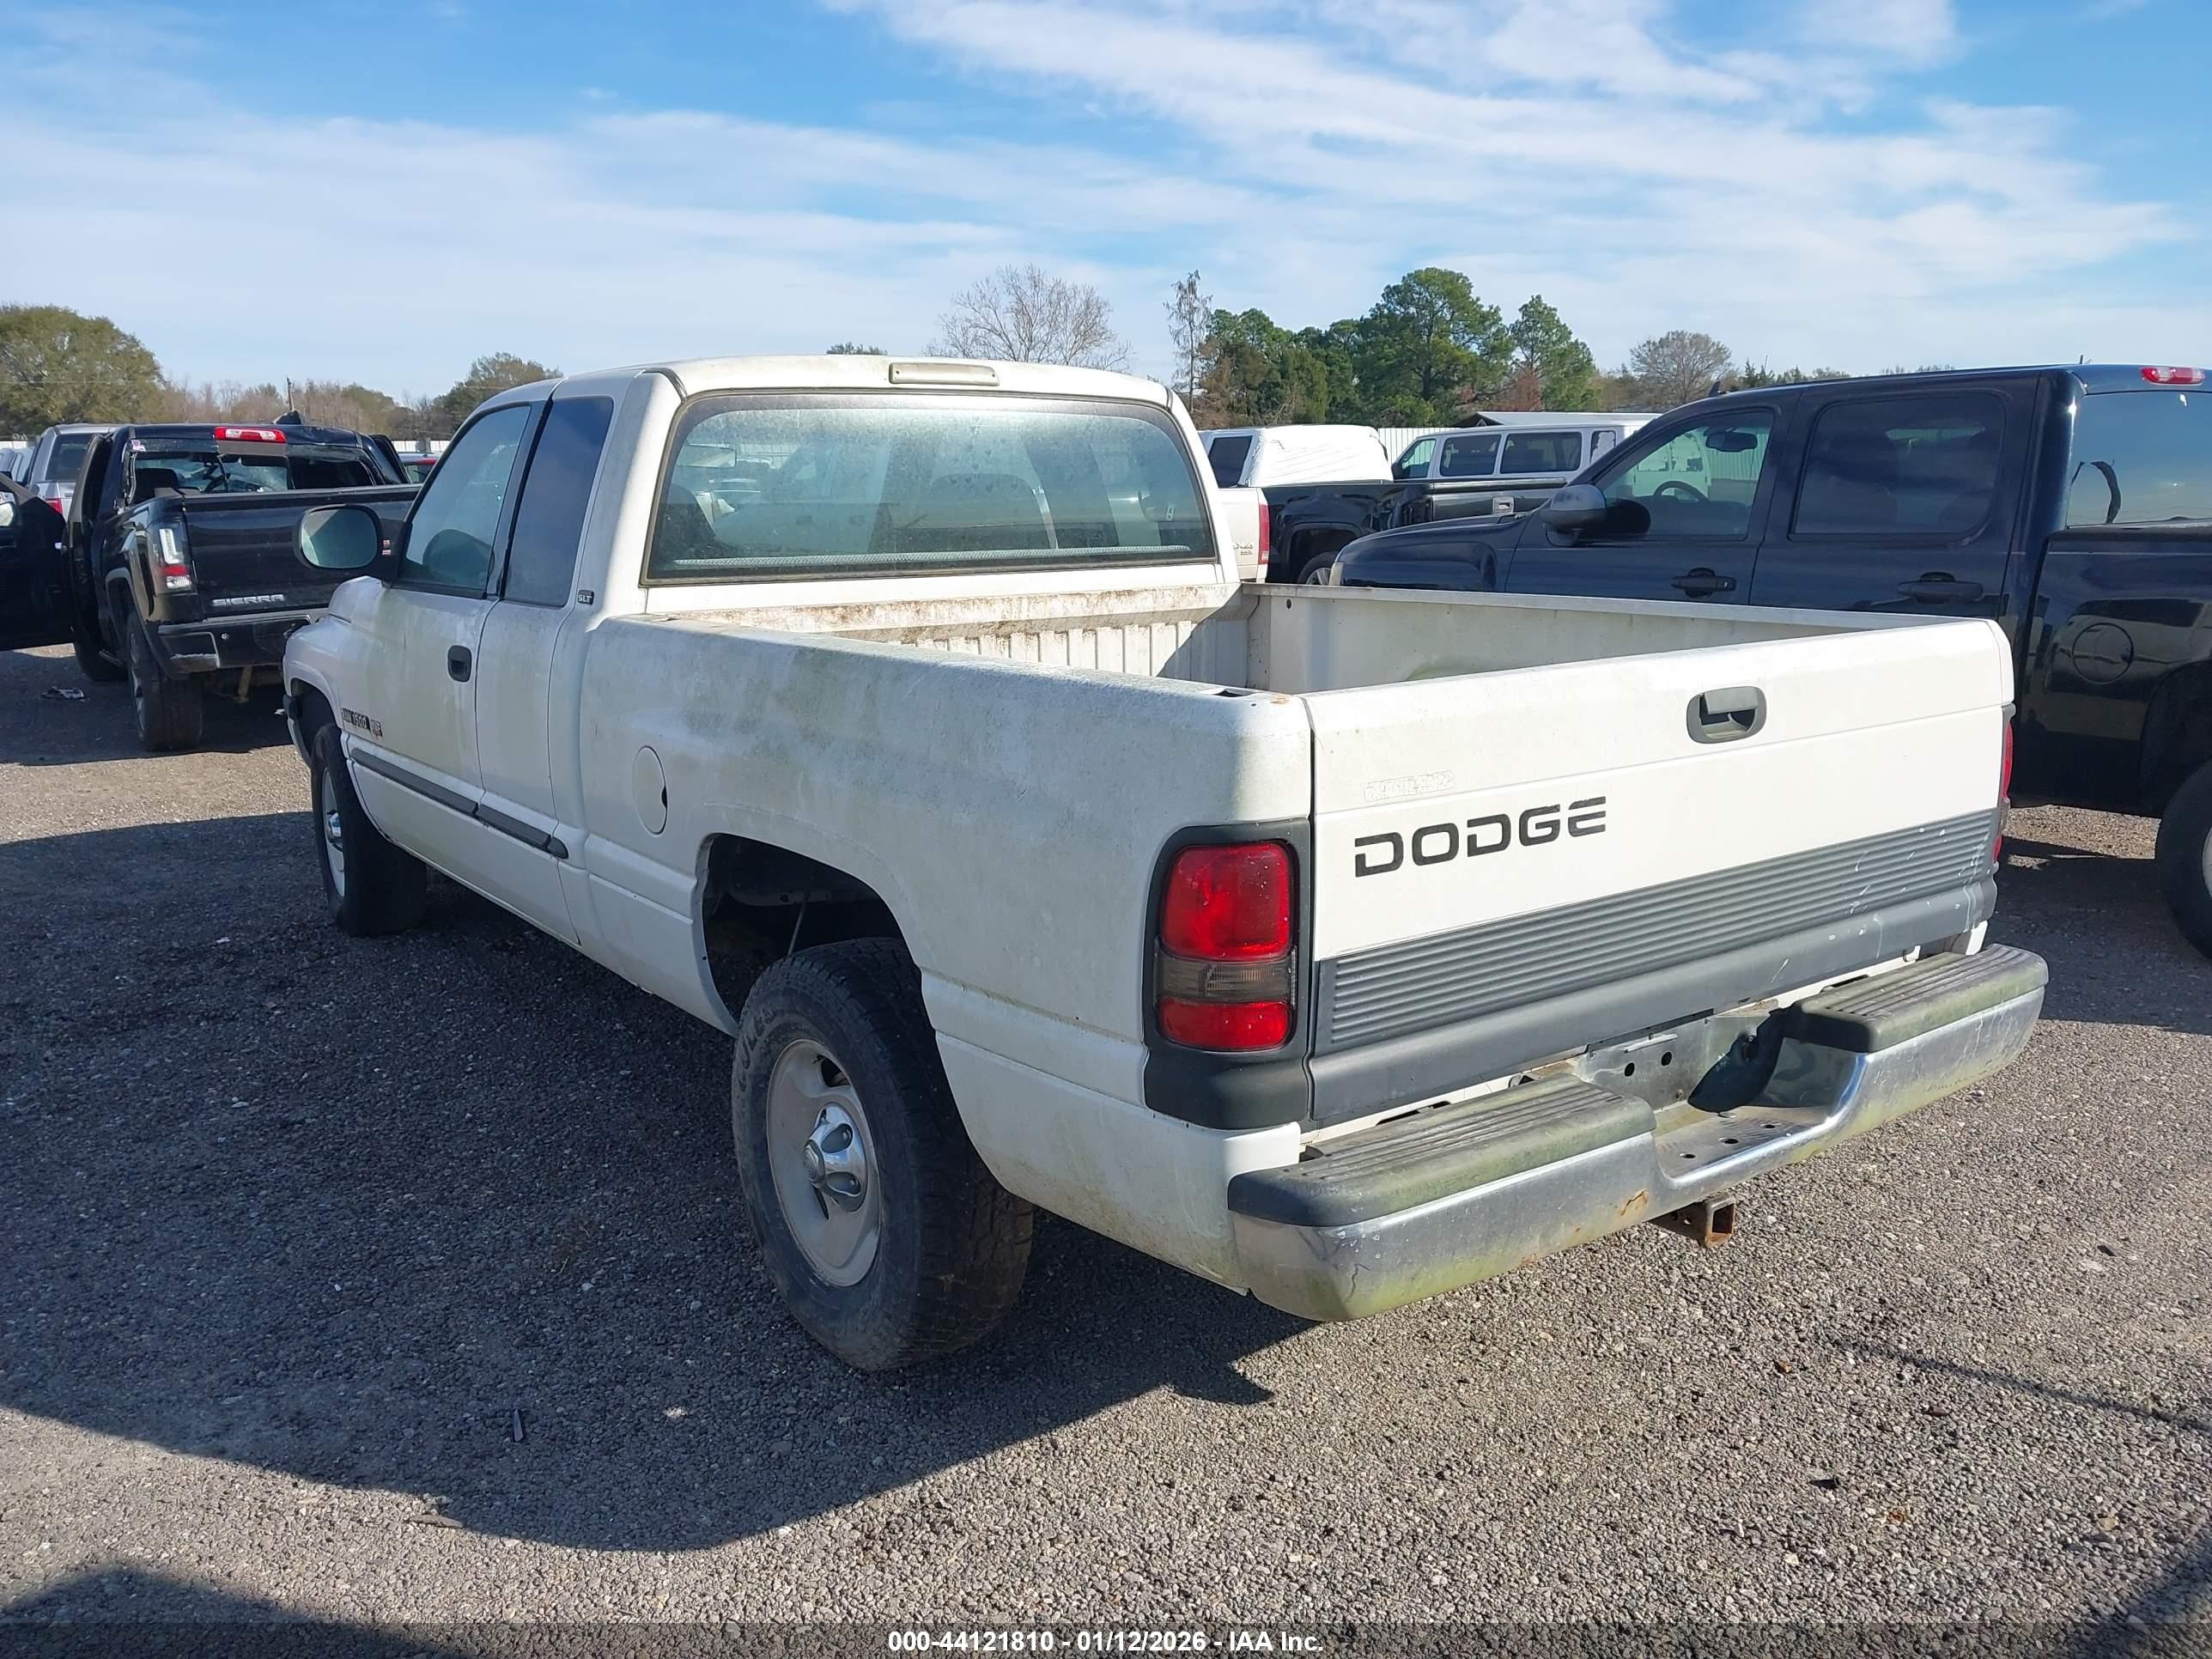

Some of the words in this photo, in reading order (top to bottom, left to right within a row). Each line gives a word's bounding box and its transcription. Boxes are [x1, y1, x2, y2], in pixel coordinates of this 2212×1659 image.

[212, 594, 284, 606] SIERRA
[578, 594, 592, 603] SLT
[1355, 796, 1606, 878] DODGE
